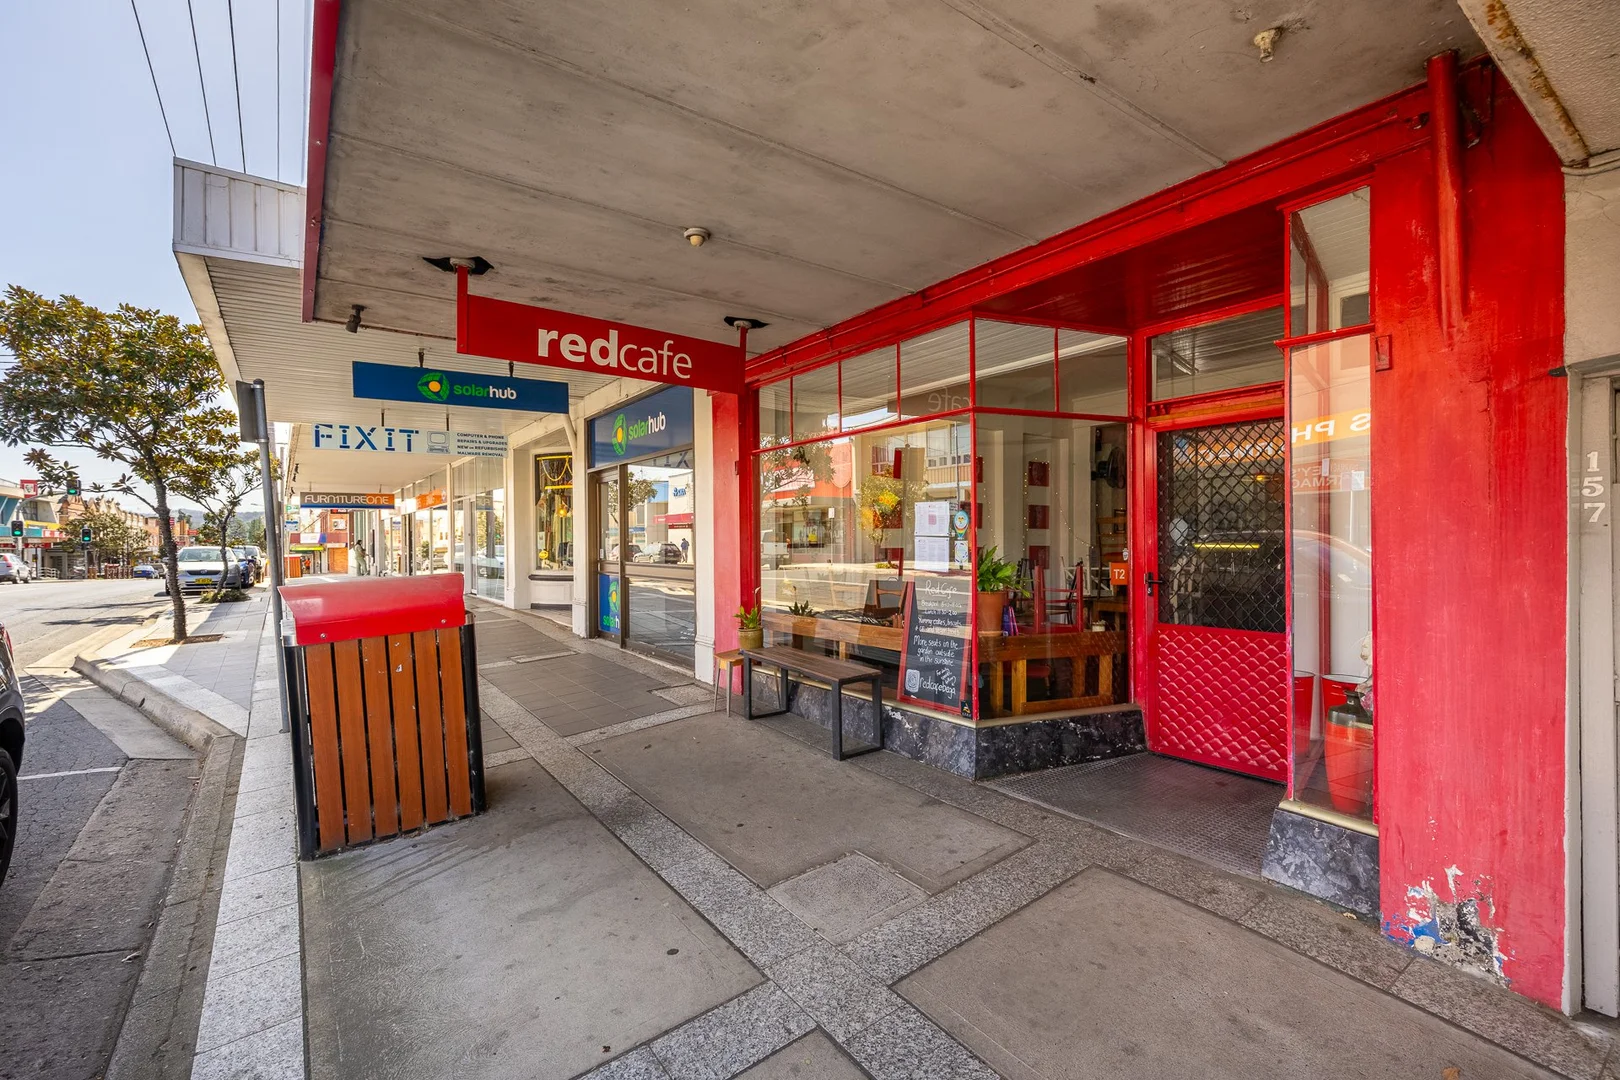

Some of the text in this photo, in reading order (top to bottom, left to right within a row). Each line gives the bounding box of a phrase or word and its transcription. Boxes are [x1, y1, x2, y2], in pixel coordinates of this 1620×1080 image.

[537, 328, 693, 379] redcafe
[453, 384, 517, 400] solarhub
[628, 411, 666, 441] solarhub
[1114, 568, 1126, 580] T2
